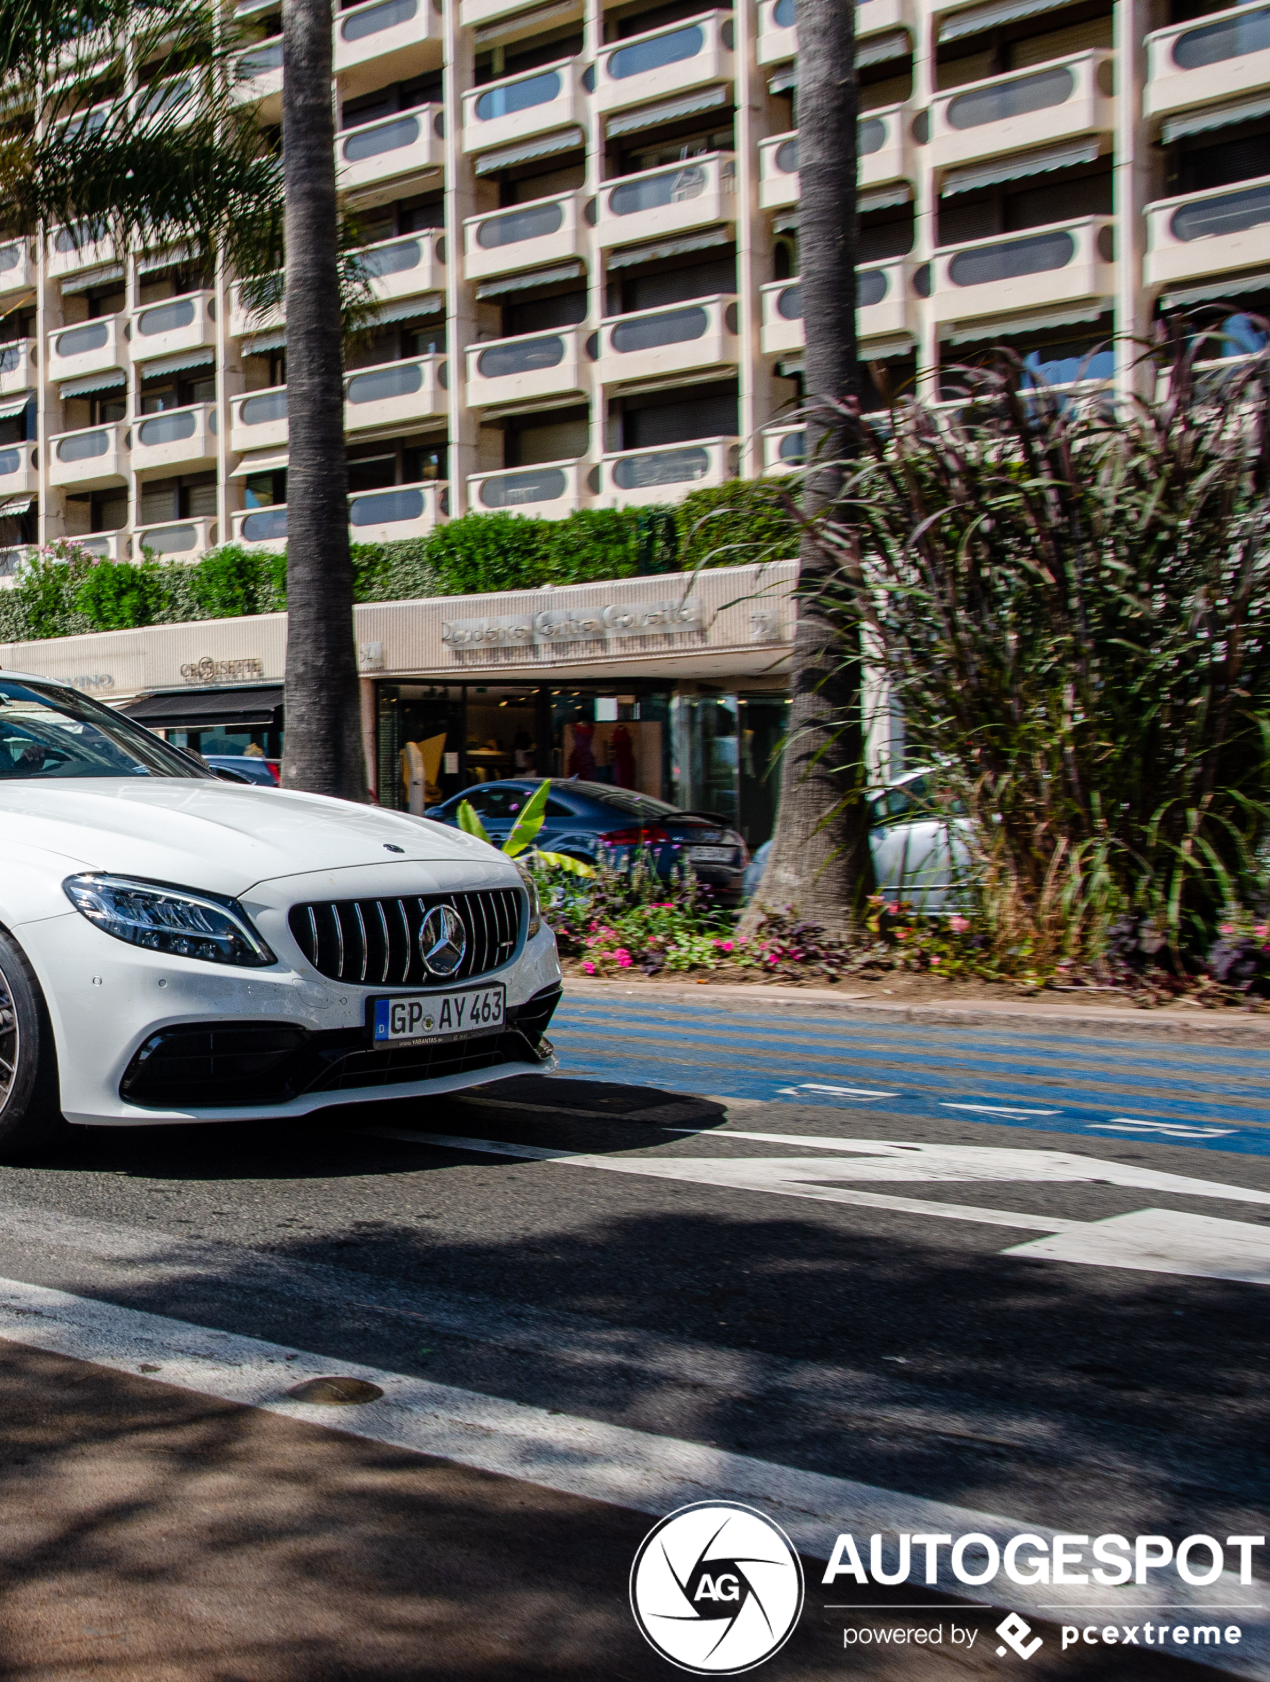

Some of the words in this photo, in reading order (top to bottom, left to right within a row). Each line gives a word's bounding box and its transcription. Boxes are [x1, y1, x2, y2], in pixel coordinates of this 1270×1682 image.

[390, 1001, 422, 1034] GP
[439, 997, 465, 1030] AY
[470, 991, 501, 1024] 463
